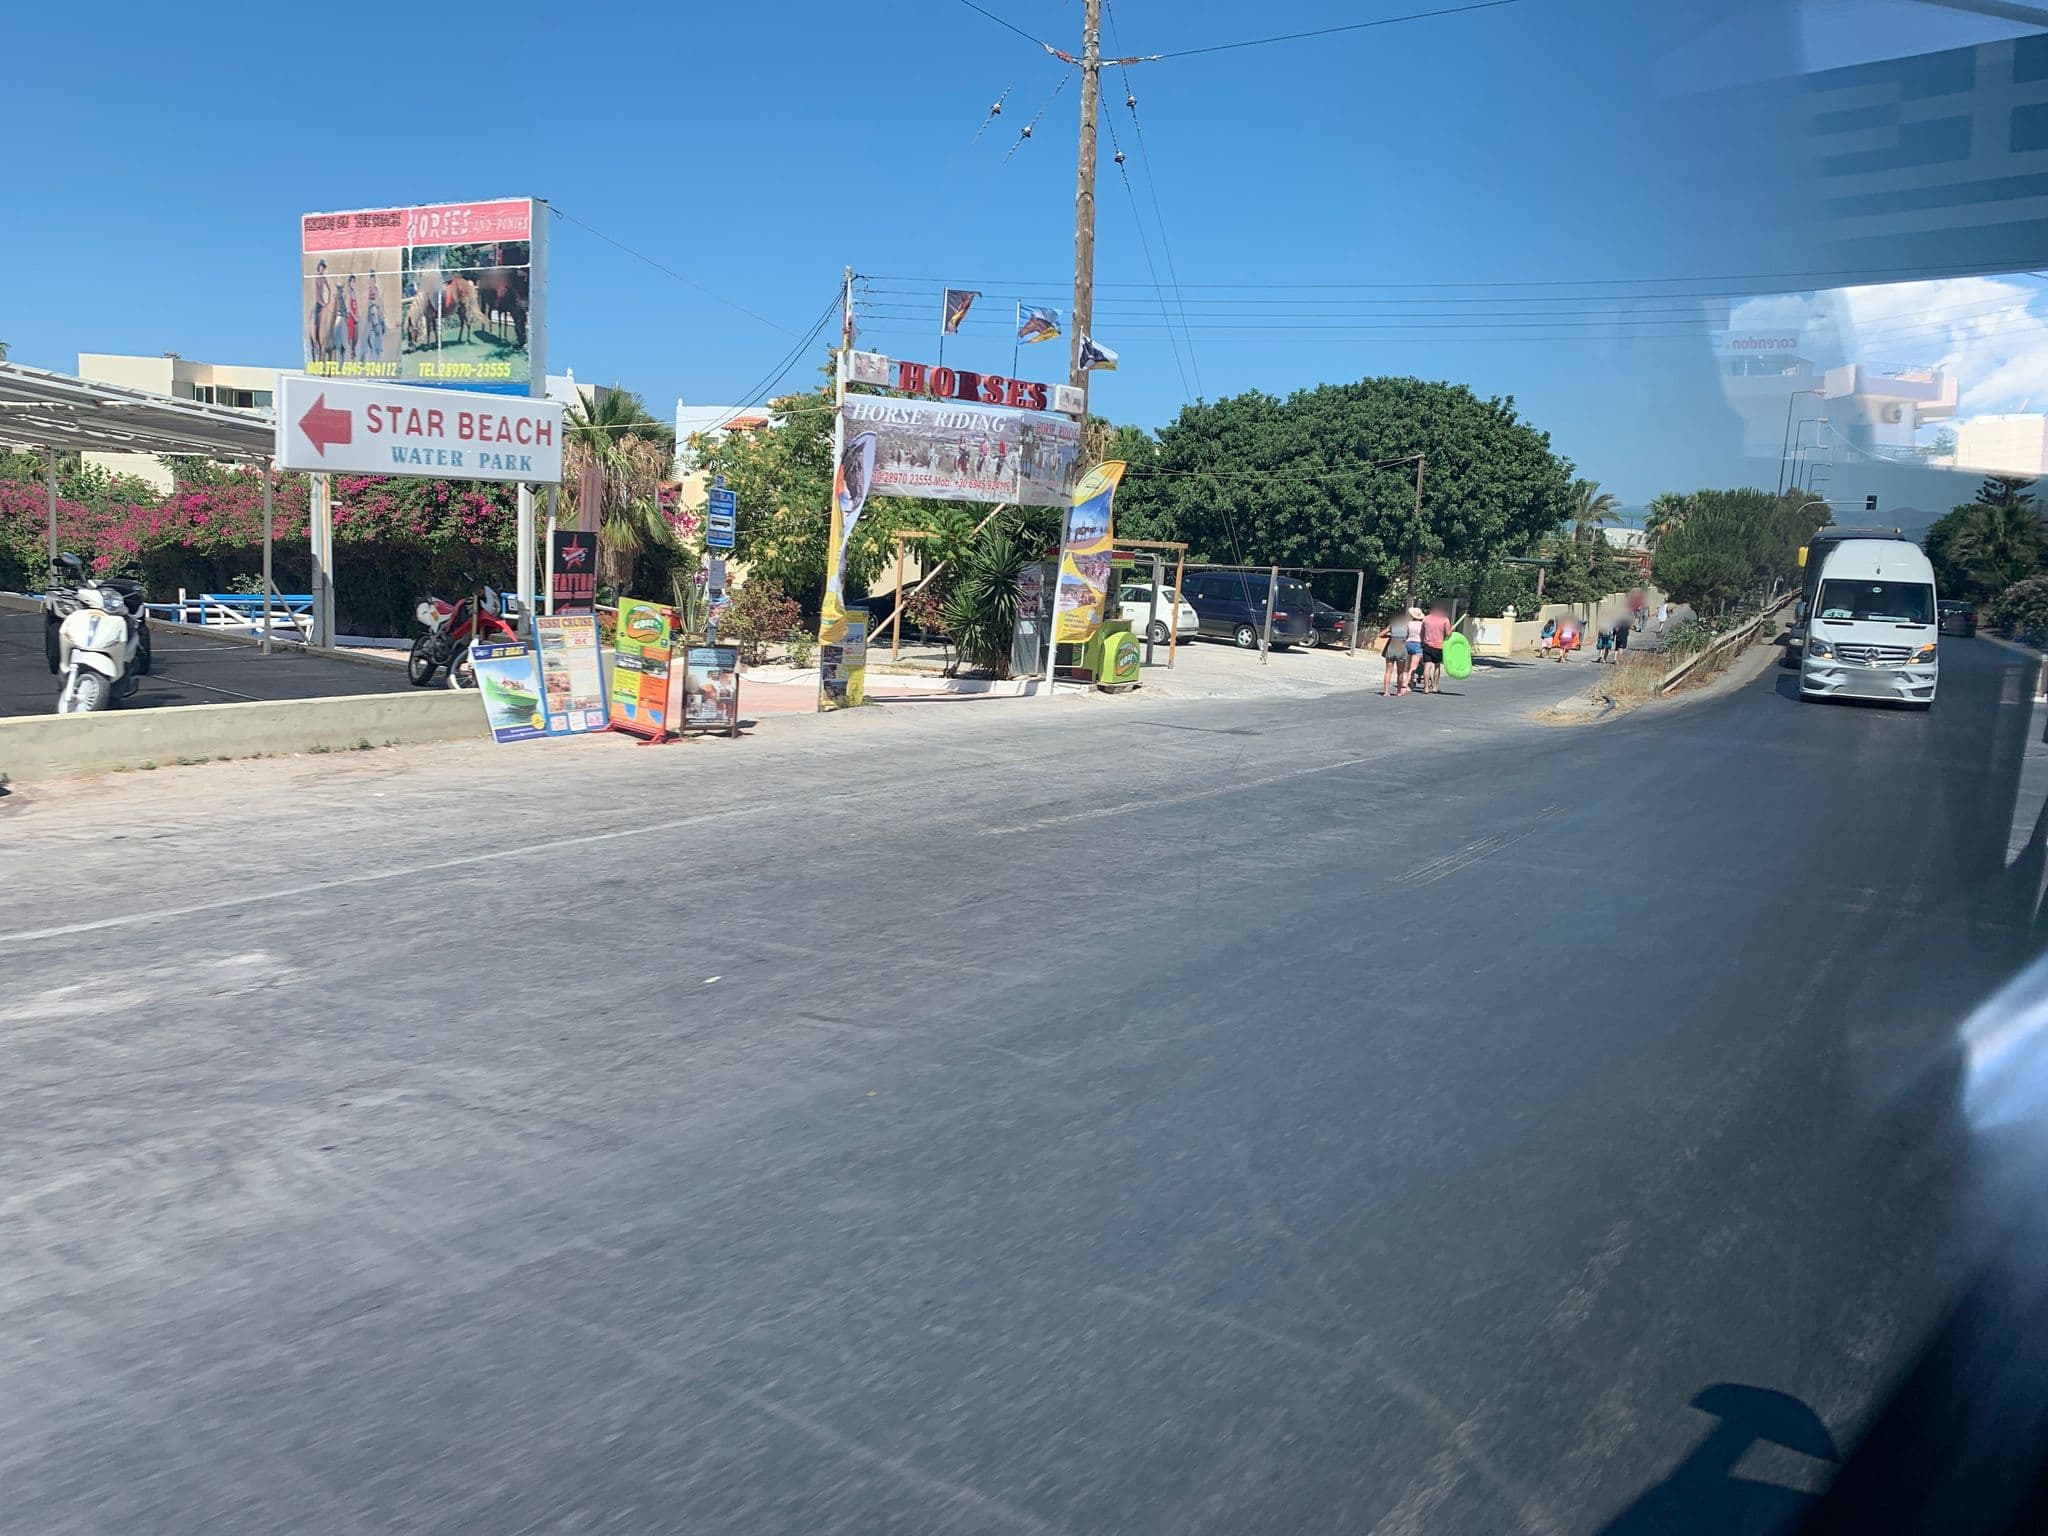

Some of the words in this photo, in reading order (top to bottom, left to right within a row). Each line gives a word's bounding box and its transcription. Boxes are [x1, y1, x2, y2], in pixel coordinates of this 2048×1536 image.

[407, 209, 471, 239] HORSES
[898, 360, 1048, 410] HORSES
[366, 403, 445, 437] STAR
[458, 412, 552, 446] BEACH
[851, 402, 926, 426] HORSE
[934, 410, 1008, 433] RIDING
[391, 446, 463, 467] WATER
[479, 452, 532, 472] PARK
[909, 474, 933, 486] 23555
[562, 617, 593, 627] CRUISE
